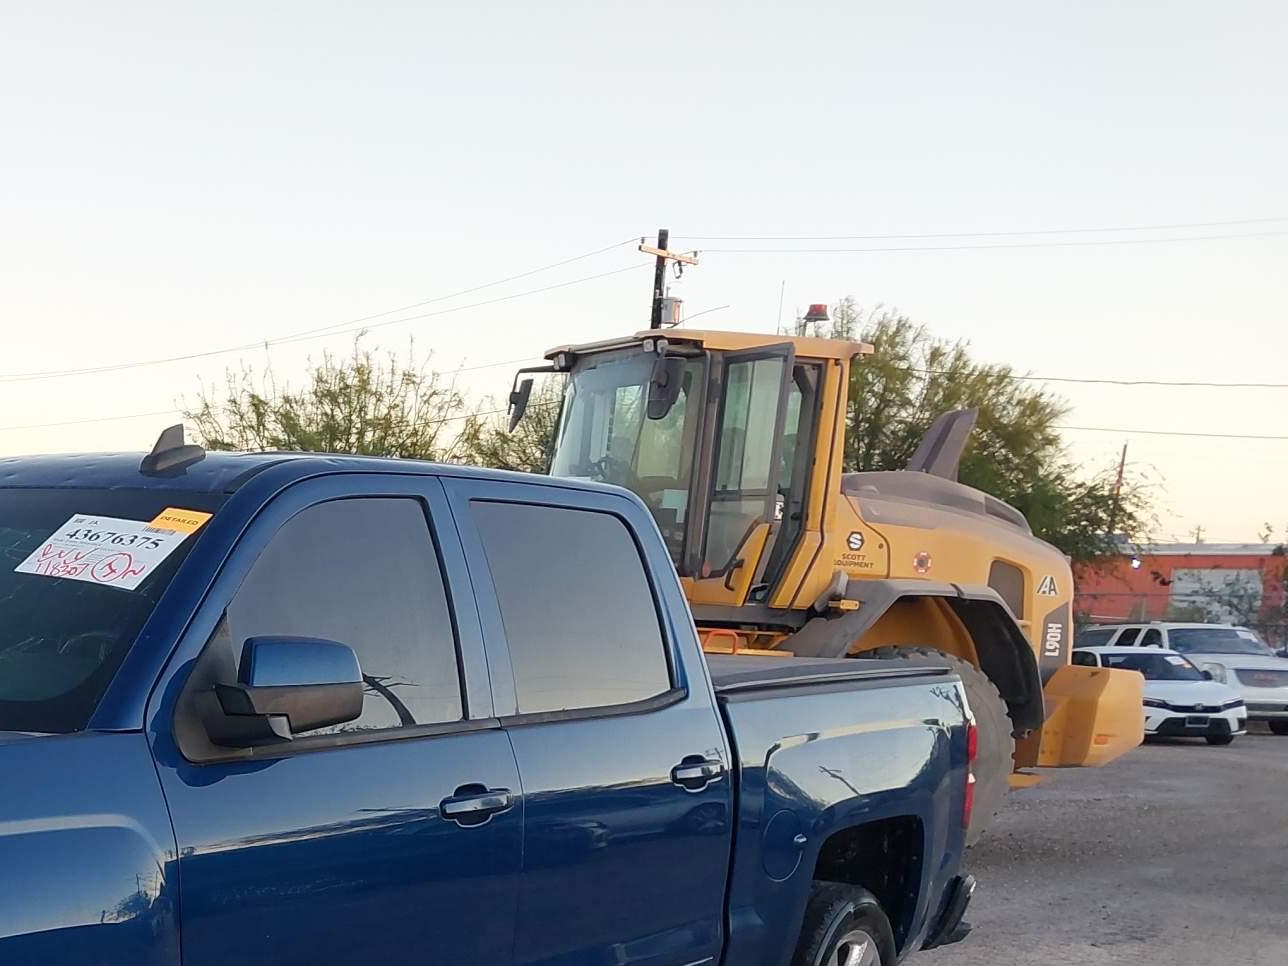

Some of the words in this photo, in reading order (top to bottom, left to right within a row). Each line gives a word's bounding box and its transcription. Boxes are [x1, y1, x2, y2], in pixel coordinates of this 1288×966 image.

[160, 515, 199, 526] DETAILED
[66, 528, 165, 550] 43676375
[842, 552, 866, 561] SCOTT
[1044, 623, 1063, 657] L90H
